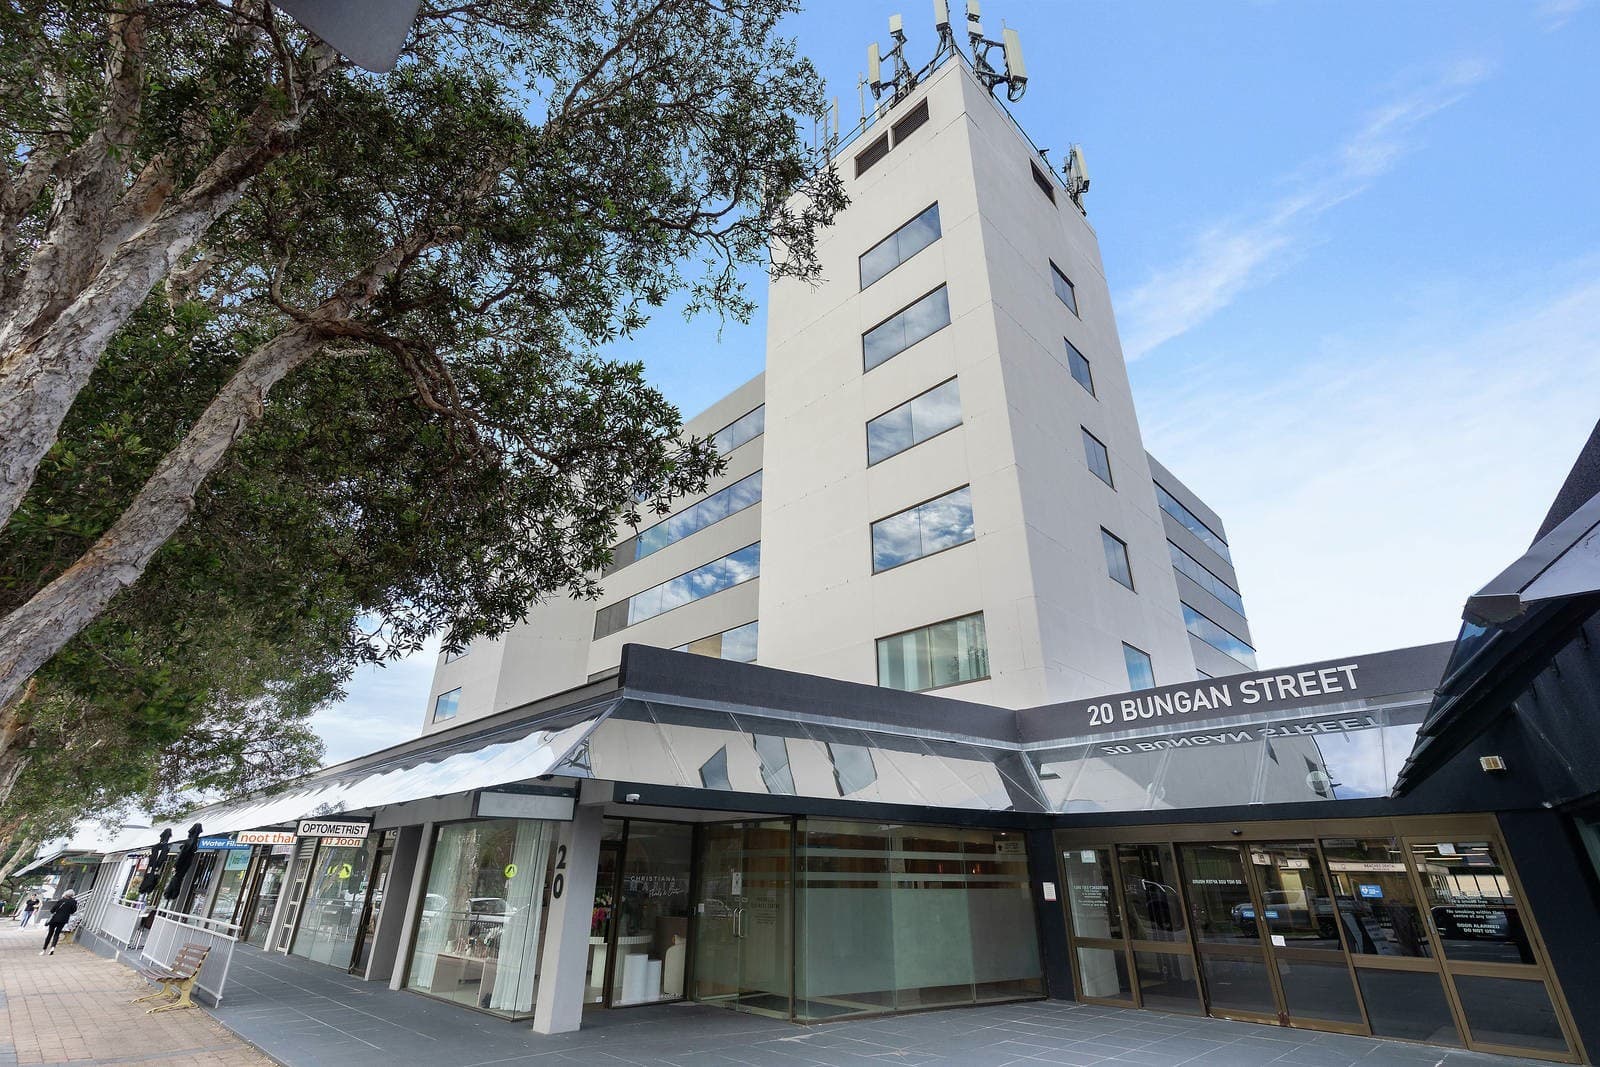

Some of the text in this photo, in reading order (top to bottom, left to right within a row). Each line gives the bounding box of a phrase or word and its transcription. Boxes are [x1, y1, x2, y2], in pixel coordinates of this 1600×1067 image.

[1087, 664, 1359, 726] 20 BUNGAN STREET
[241, 834, 270, 842] noot
[302, 823, 367, 835] OPTOMETRIST
[553, 844, 567, 899] 20
